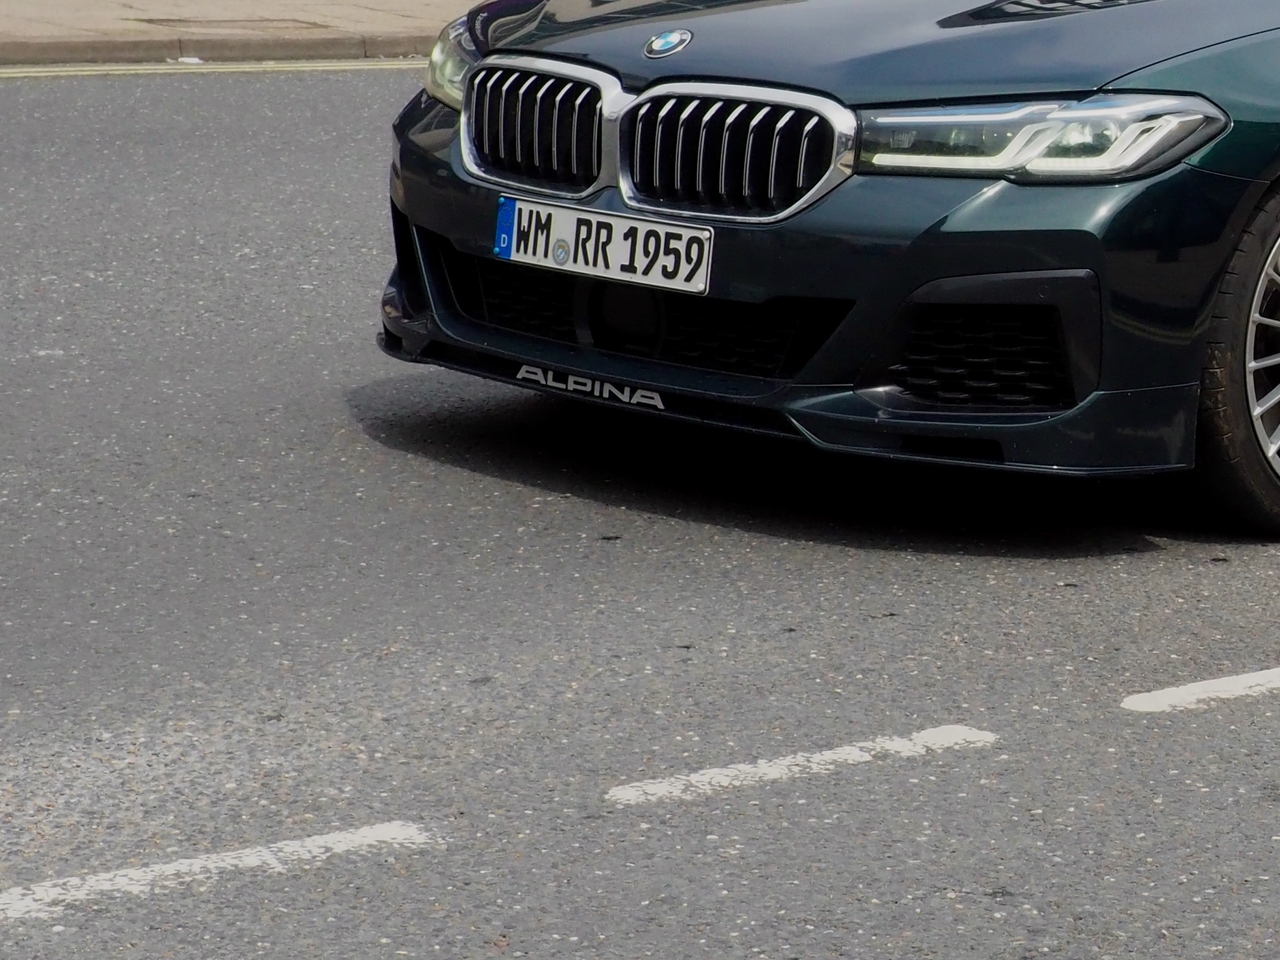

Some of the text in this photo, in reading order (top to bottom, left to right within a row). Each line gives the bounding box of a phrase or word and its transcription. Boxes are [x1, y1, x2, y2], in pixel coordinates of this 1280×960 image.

[501, 207, 705, 283] D WM RR 1959
[516, 364, 665, 410] ALPINA
